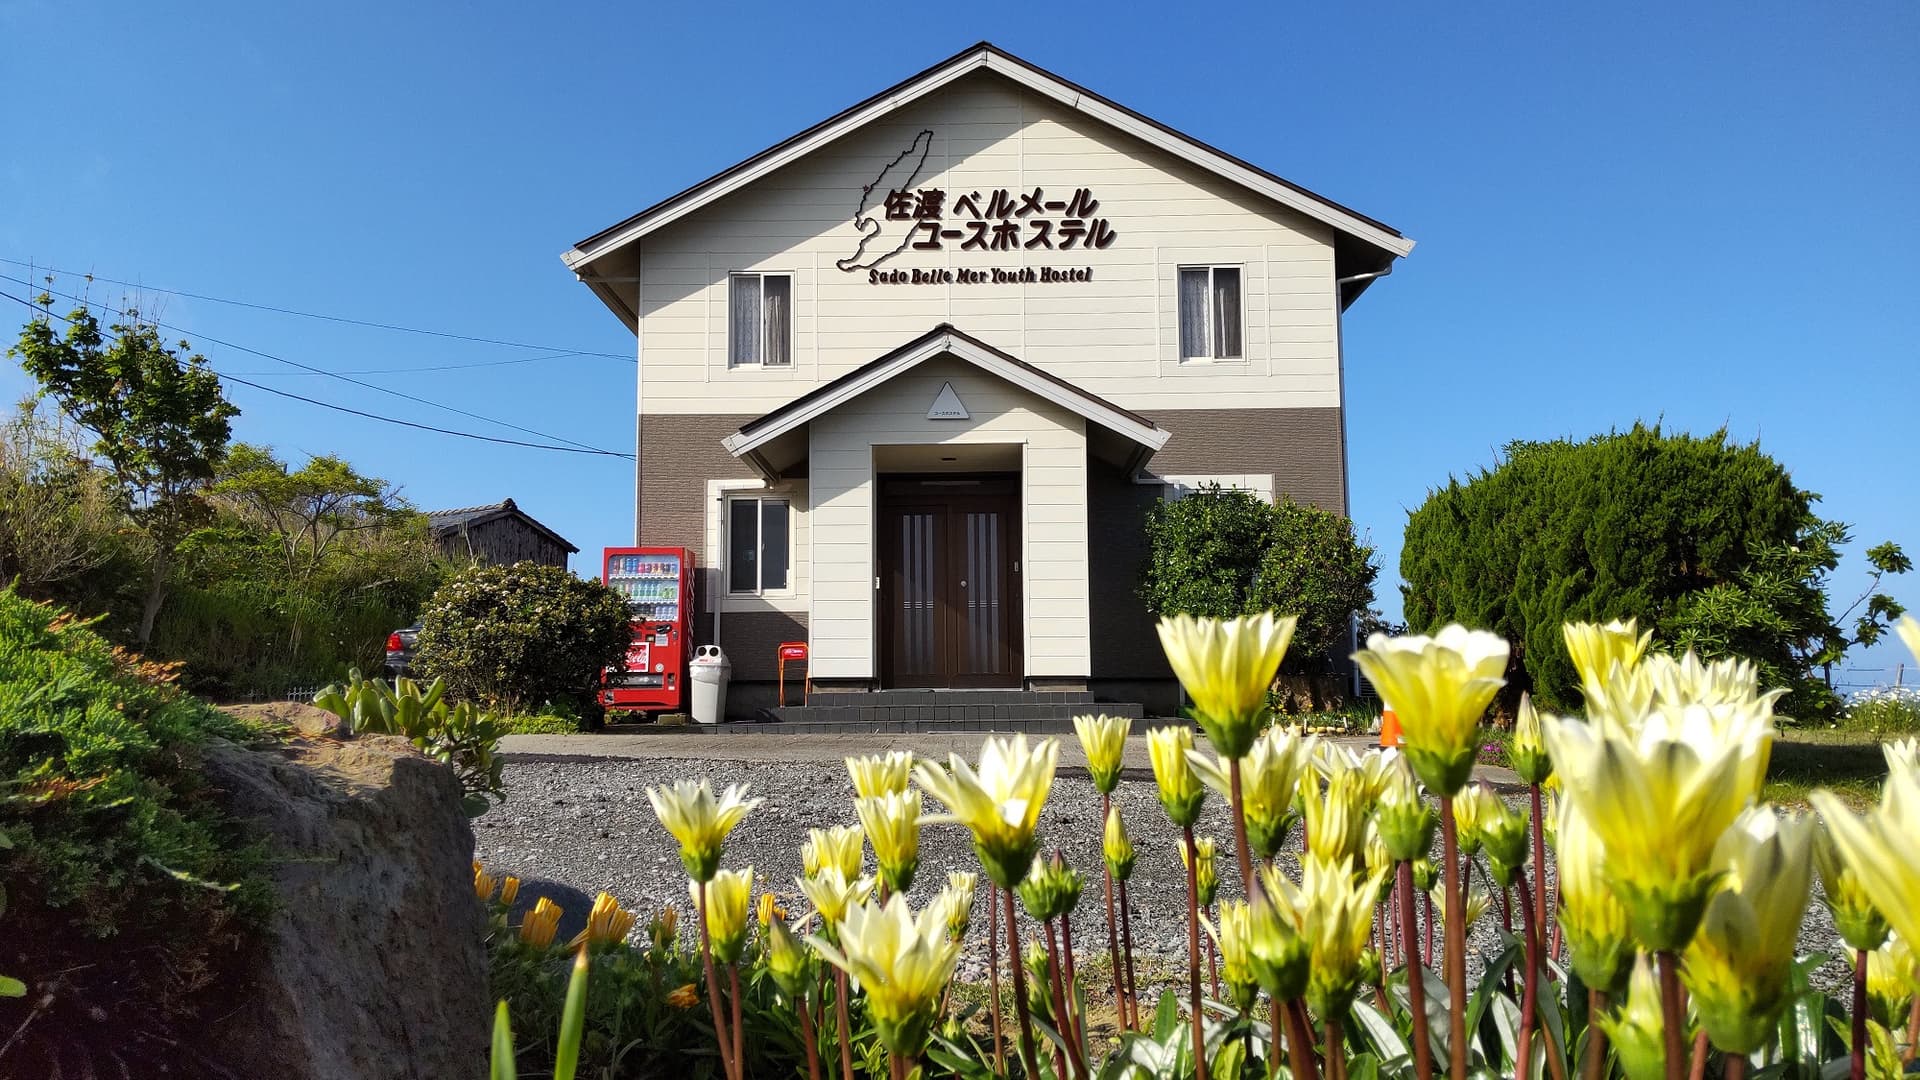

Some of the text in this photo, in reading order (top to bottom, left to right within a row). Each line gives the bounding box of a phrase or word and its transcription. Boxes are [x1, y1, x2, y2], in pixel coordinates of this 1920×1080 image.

[884, 187, 1097, 220] 佐渡 ベルメール
[913, 218, 1115, 250] ユースホステル
[868, 266, 1092, 283] Sado Belle Mer Youth Hostel
